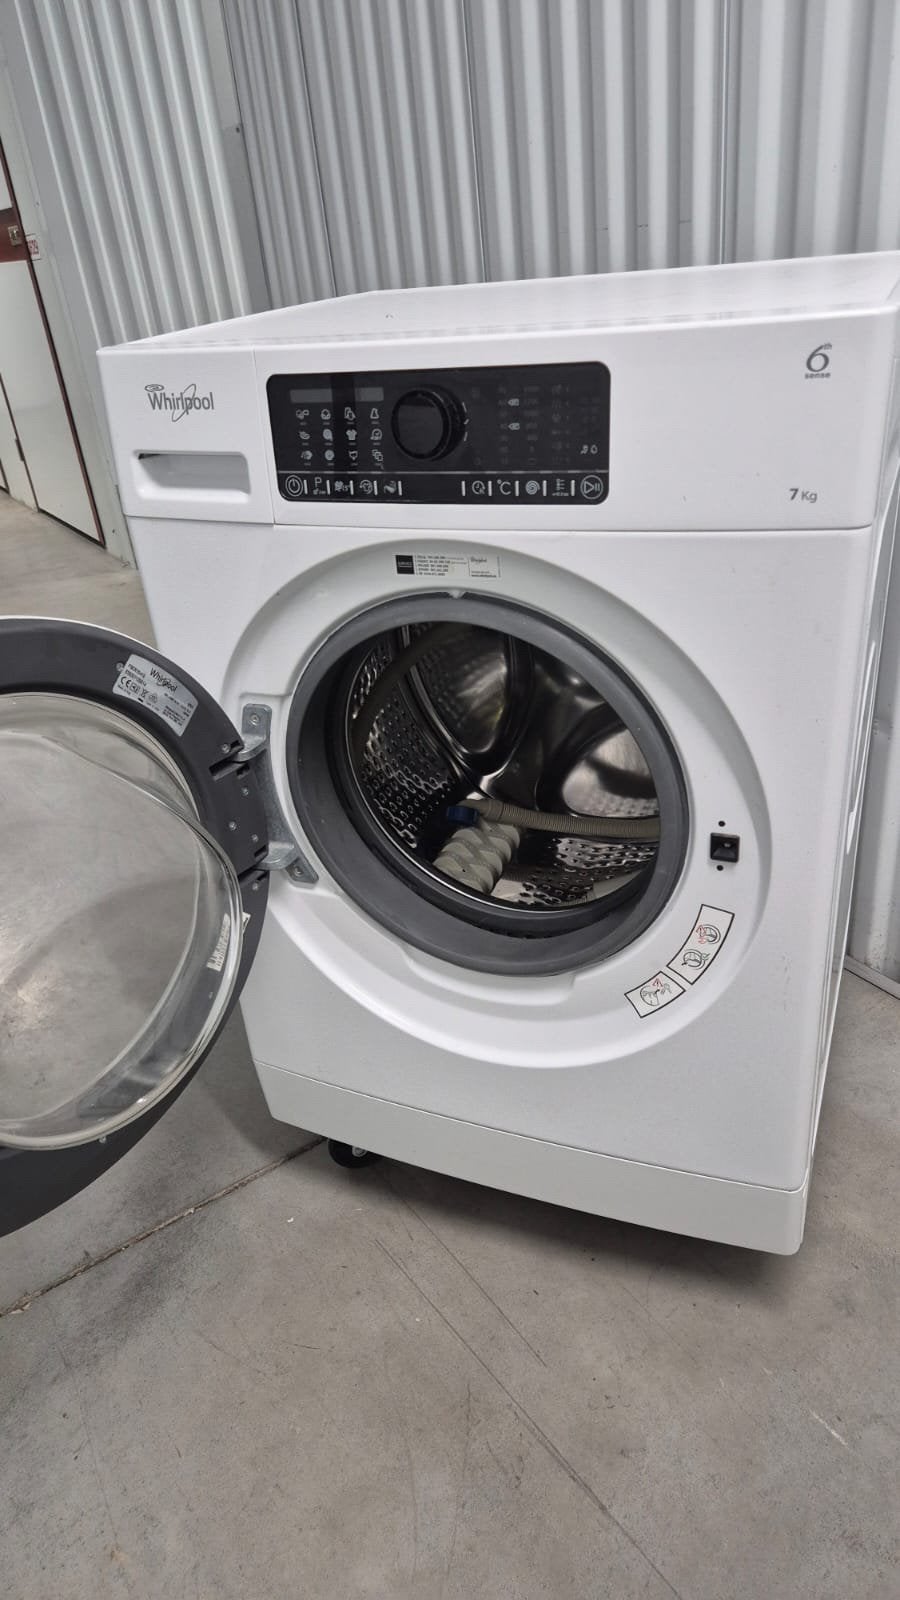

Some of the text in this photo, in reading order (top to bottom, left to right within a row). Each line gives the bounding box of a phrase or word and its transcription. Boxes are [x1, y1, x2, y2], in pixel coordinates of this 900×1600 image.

[804, 372, 831, 380] sense
[147, 391, 214, 416] Whirlpool
[789, 487, 818, 504] 7 Kg
[150, 667, 178, 692] Whirlpool
